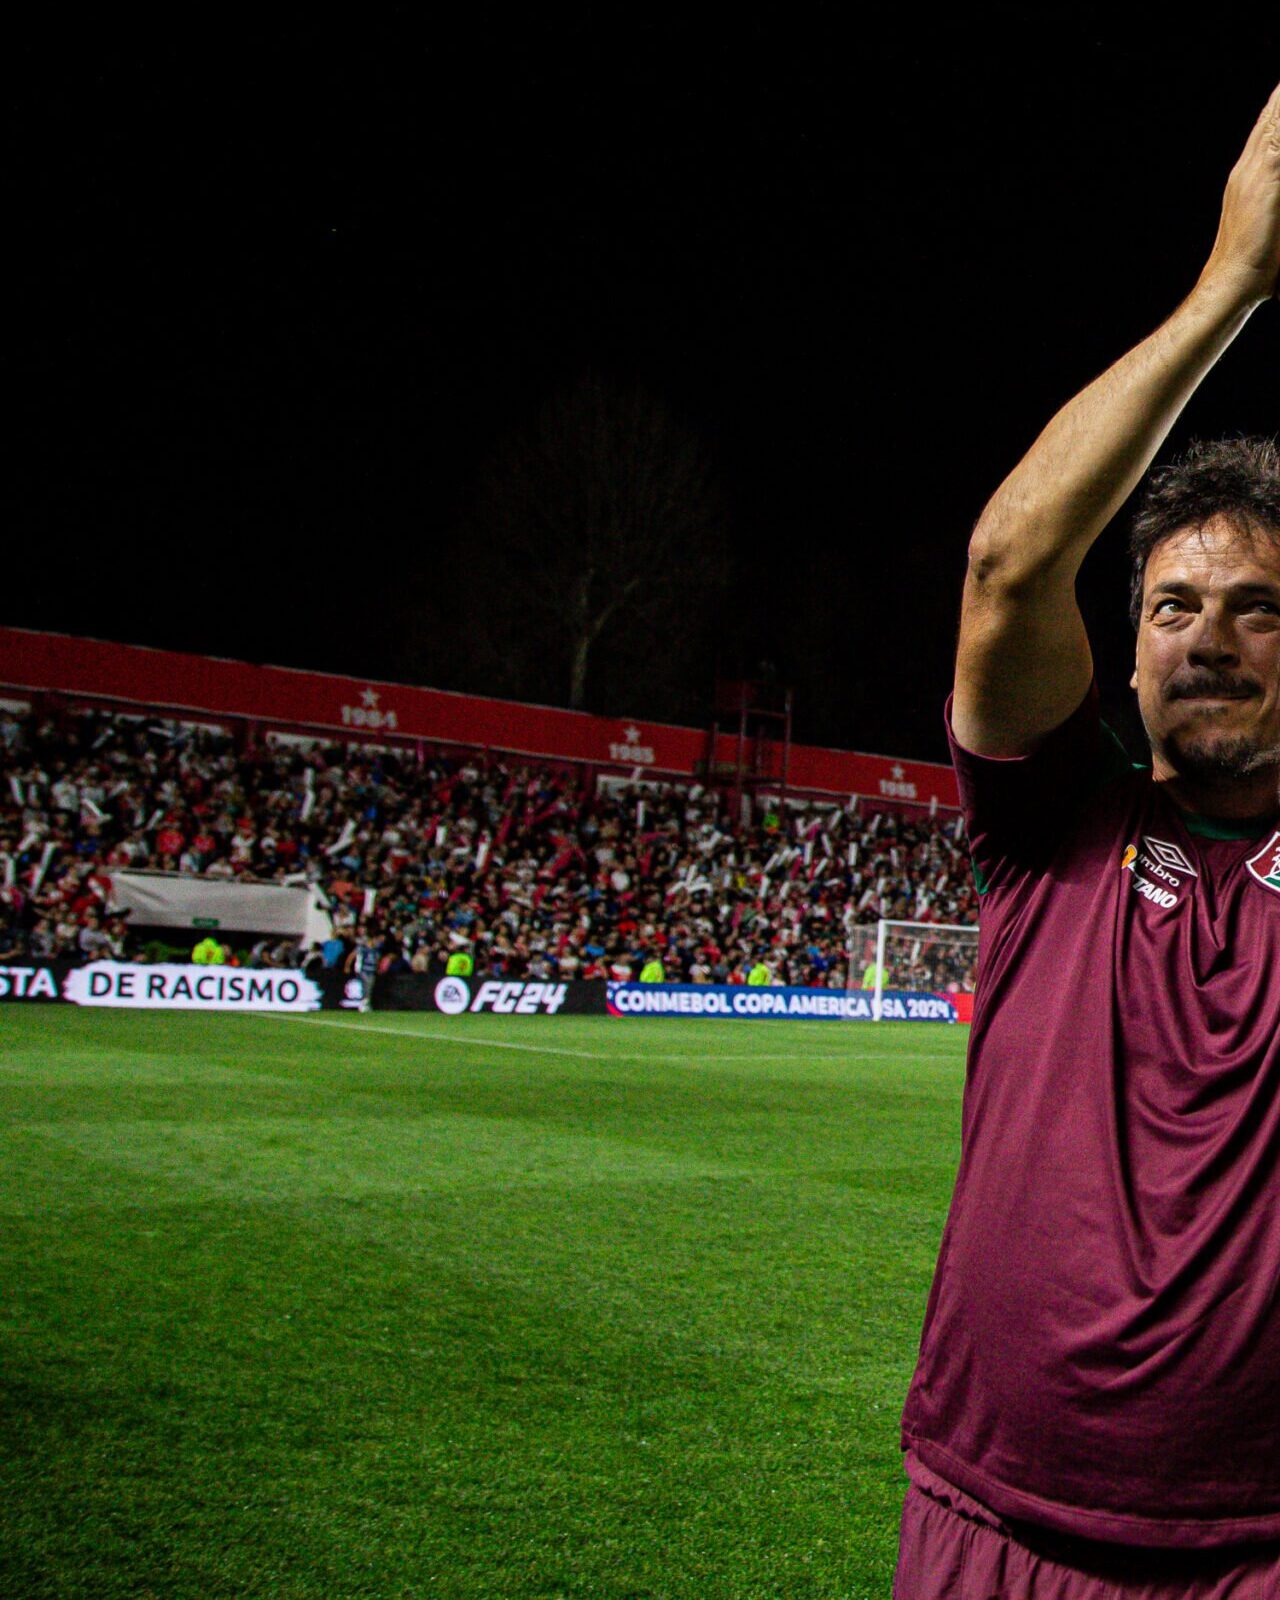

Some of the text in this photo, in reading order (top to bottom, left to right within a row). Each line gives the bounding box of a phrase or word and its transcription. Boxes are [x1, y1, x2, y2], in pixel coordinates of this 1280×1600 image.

[1138, 854, 1180, 887] mbro
[90, 972, 299, 1002] DE RACISMO
[615, 990, 950, 1019] CONMEBOL COPA AMERICA SA 2024
